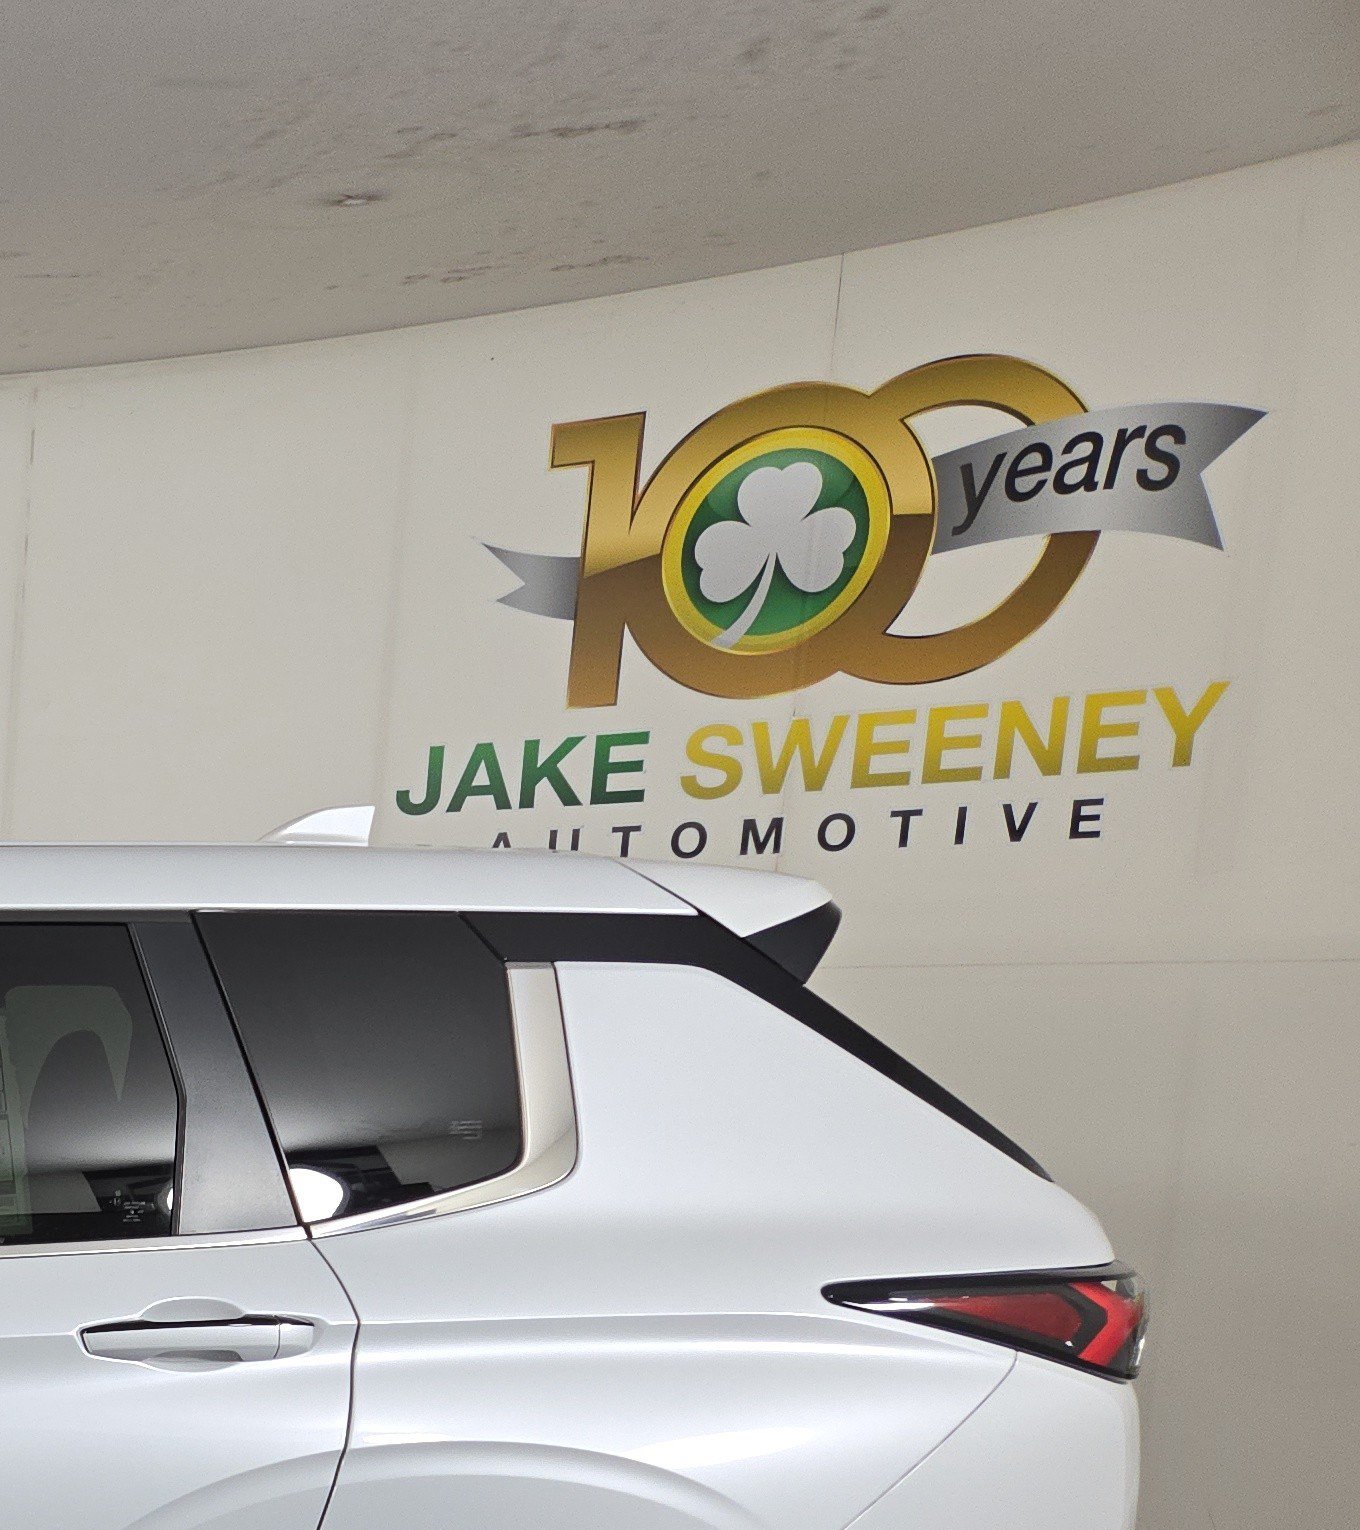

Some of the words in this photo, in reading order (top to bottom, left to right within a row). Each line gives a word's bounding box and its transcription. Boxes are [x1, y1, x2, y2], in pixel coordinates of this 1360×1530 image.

[550, 353, 1099, 709] 100
[951, 423, 1188, 537] years
[395, 730, 651, 817] JAKE
[680, 680, 1231, 800] SWEENEY
